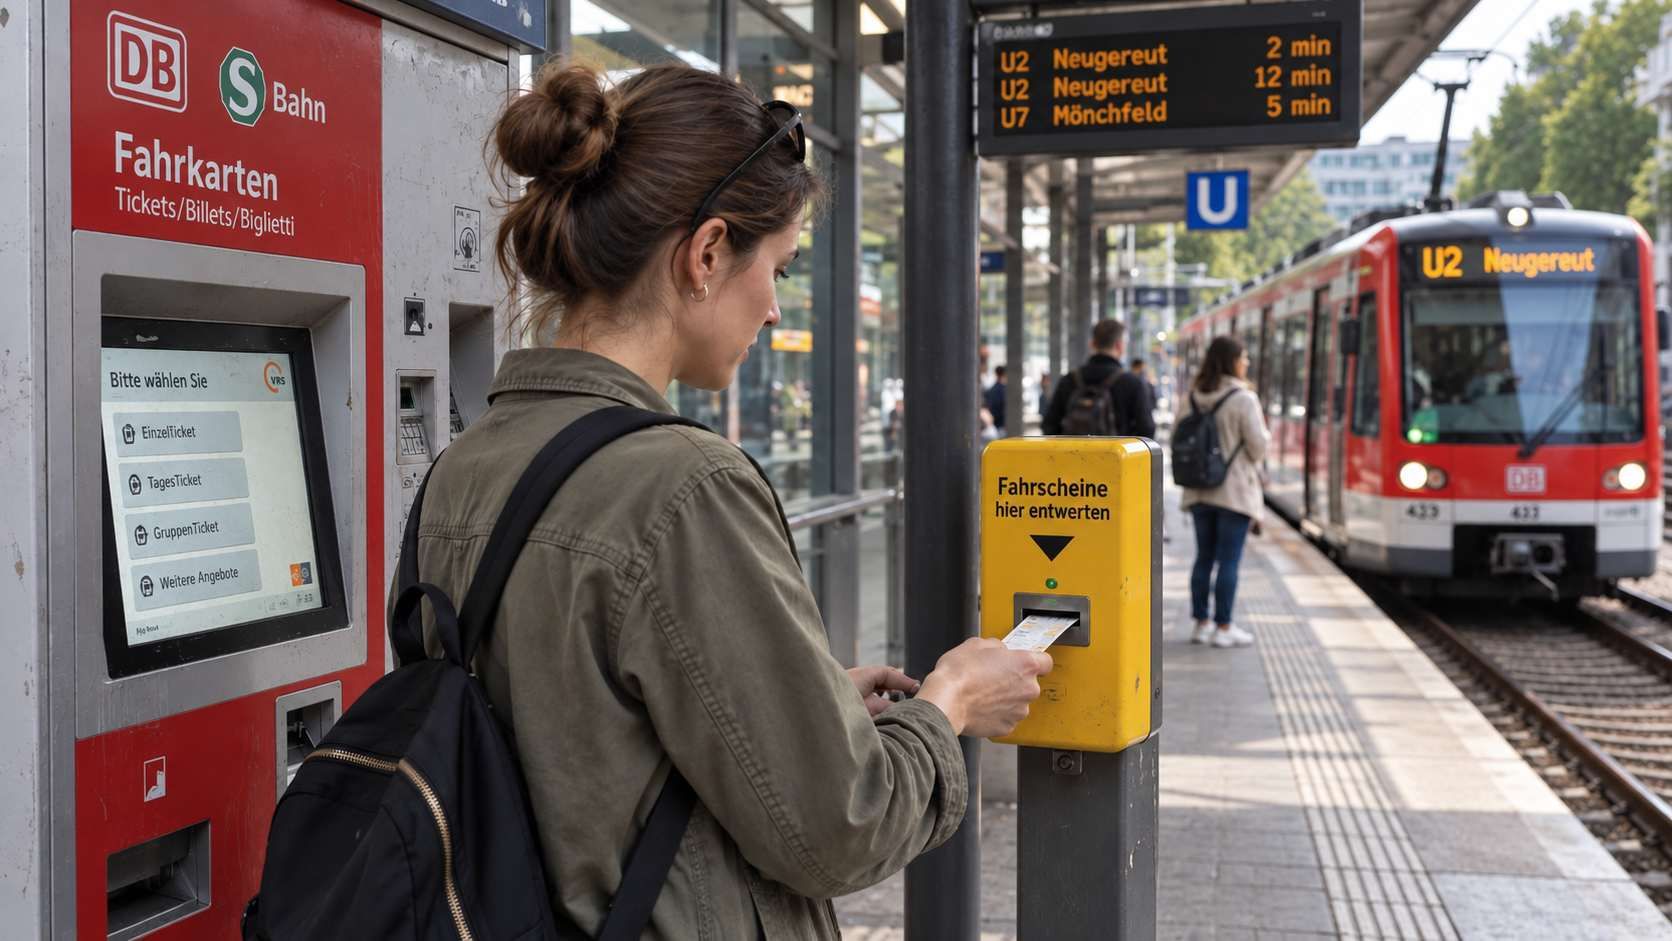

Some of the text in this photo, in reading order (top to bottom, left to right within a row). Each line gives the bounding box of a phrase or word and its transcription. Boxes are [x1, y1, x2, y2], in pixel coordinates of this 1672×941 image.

[119, 32, 177, 93] DB
[1000, 34, 1331, 73] U2 Neugereut 2 min
[228, 57, 326, 124] S Bahn
[1000, 65, 1331, 101] U2 Neugereut 12 min
[1000, 93, 1331, 128] U7 Mönchfeld 5 min
[114, 131, 278, 201] Fahrkarten
[114, 186, 295, 237] Tickets/Billets/Biglietti
[1197, 177, 1237, 224] U
[1422, 246, 1595, 278] U2 Neugereut
[110, 371, 208, 389] Bitte wählen Sie
[270, 376, 286, 385] VRS
[142, 425, 196, 439] EinzelTicket
[147, 474, 202, 491] TagesTicket
[998, 476, 1108, 498] Fahrscheine
[1511, 469, 1541, 489] DB
[995, 501, 1110, 520] hier entwerten
[153, 521, 219, 541] GruppenTicket
[160, 568, 239, 589] Weitere Angebote
